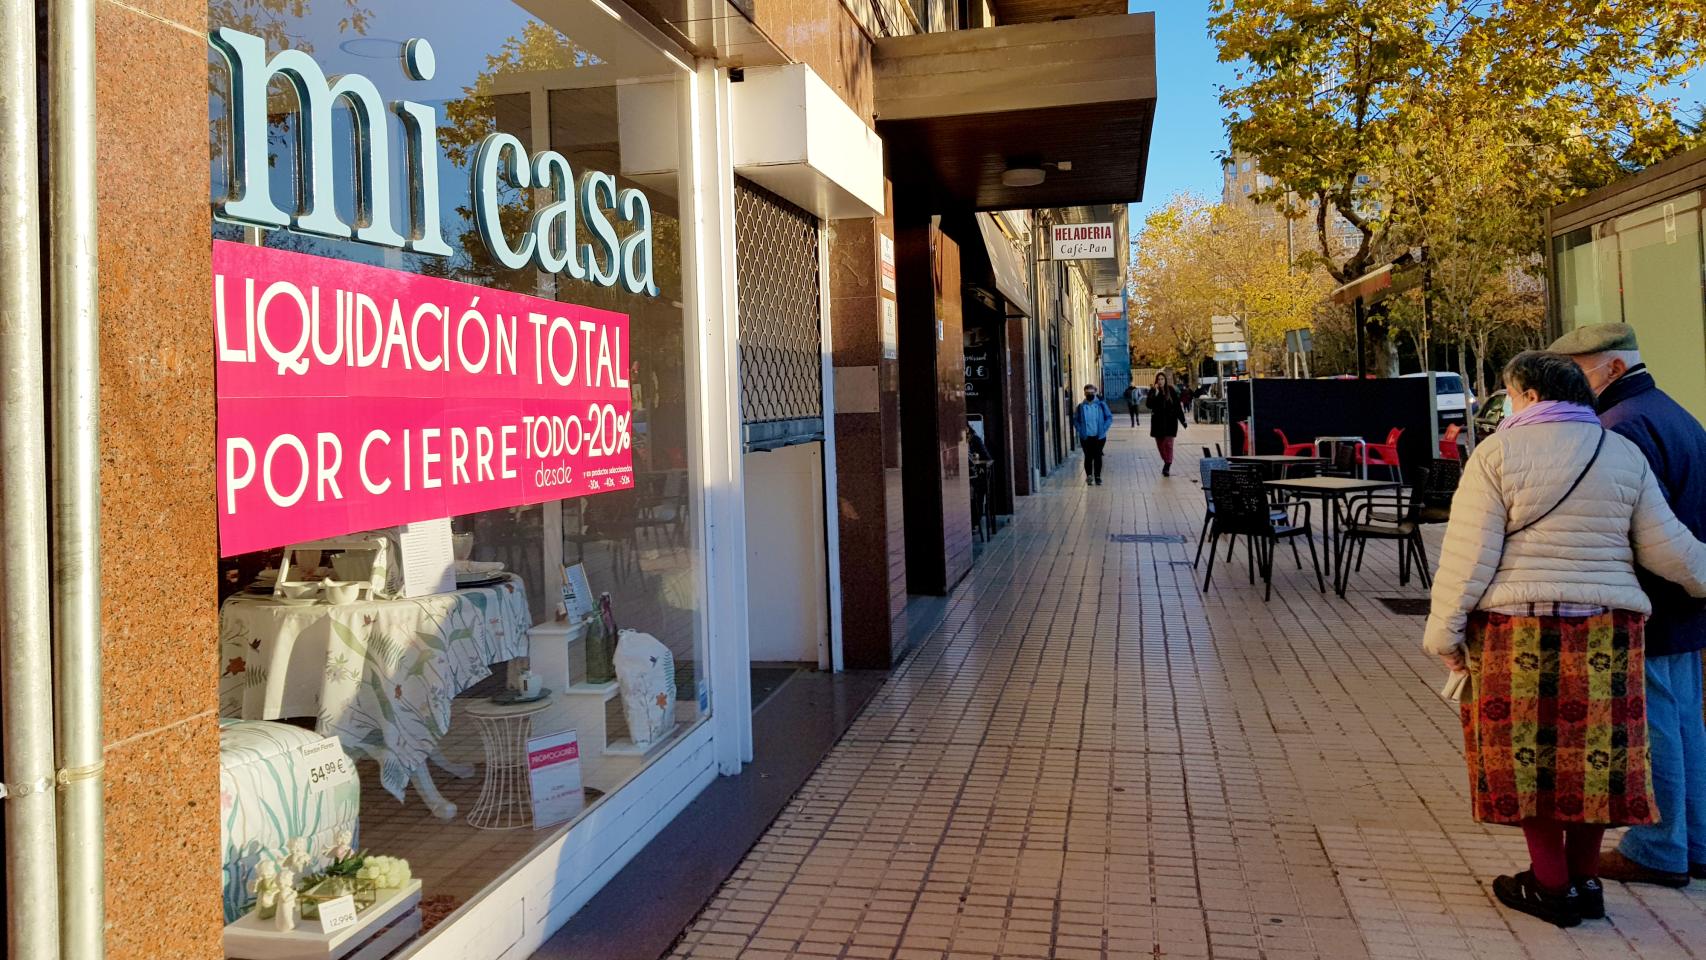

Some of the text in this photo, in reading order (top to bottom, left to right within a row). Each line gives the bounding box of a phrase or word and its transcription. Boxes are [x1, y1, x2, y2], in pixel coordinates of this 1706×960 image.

[208, 27, 660, 297] mi casa
[1055, 226, 1112, 241] HELADERIA
[1060, 243, 1107, 257] Café-Pan
[217, 273, 630, 389] LIQUIDACIÓN TOTAL
[226, 425, 518, 515] POR CIERRE
[535, 459, 573, 488] desde
[311, 758, 346, 783] 54,99 €
